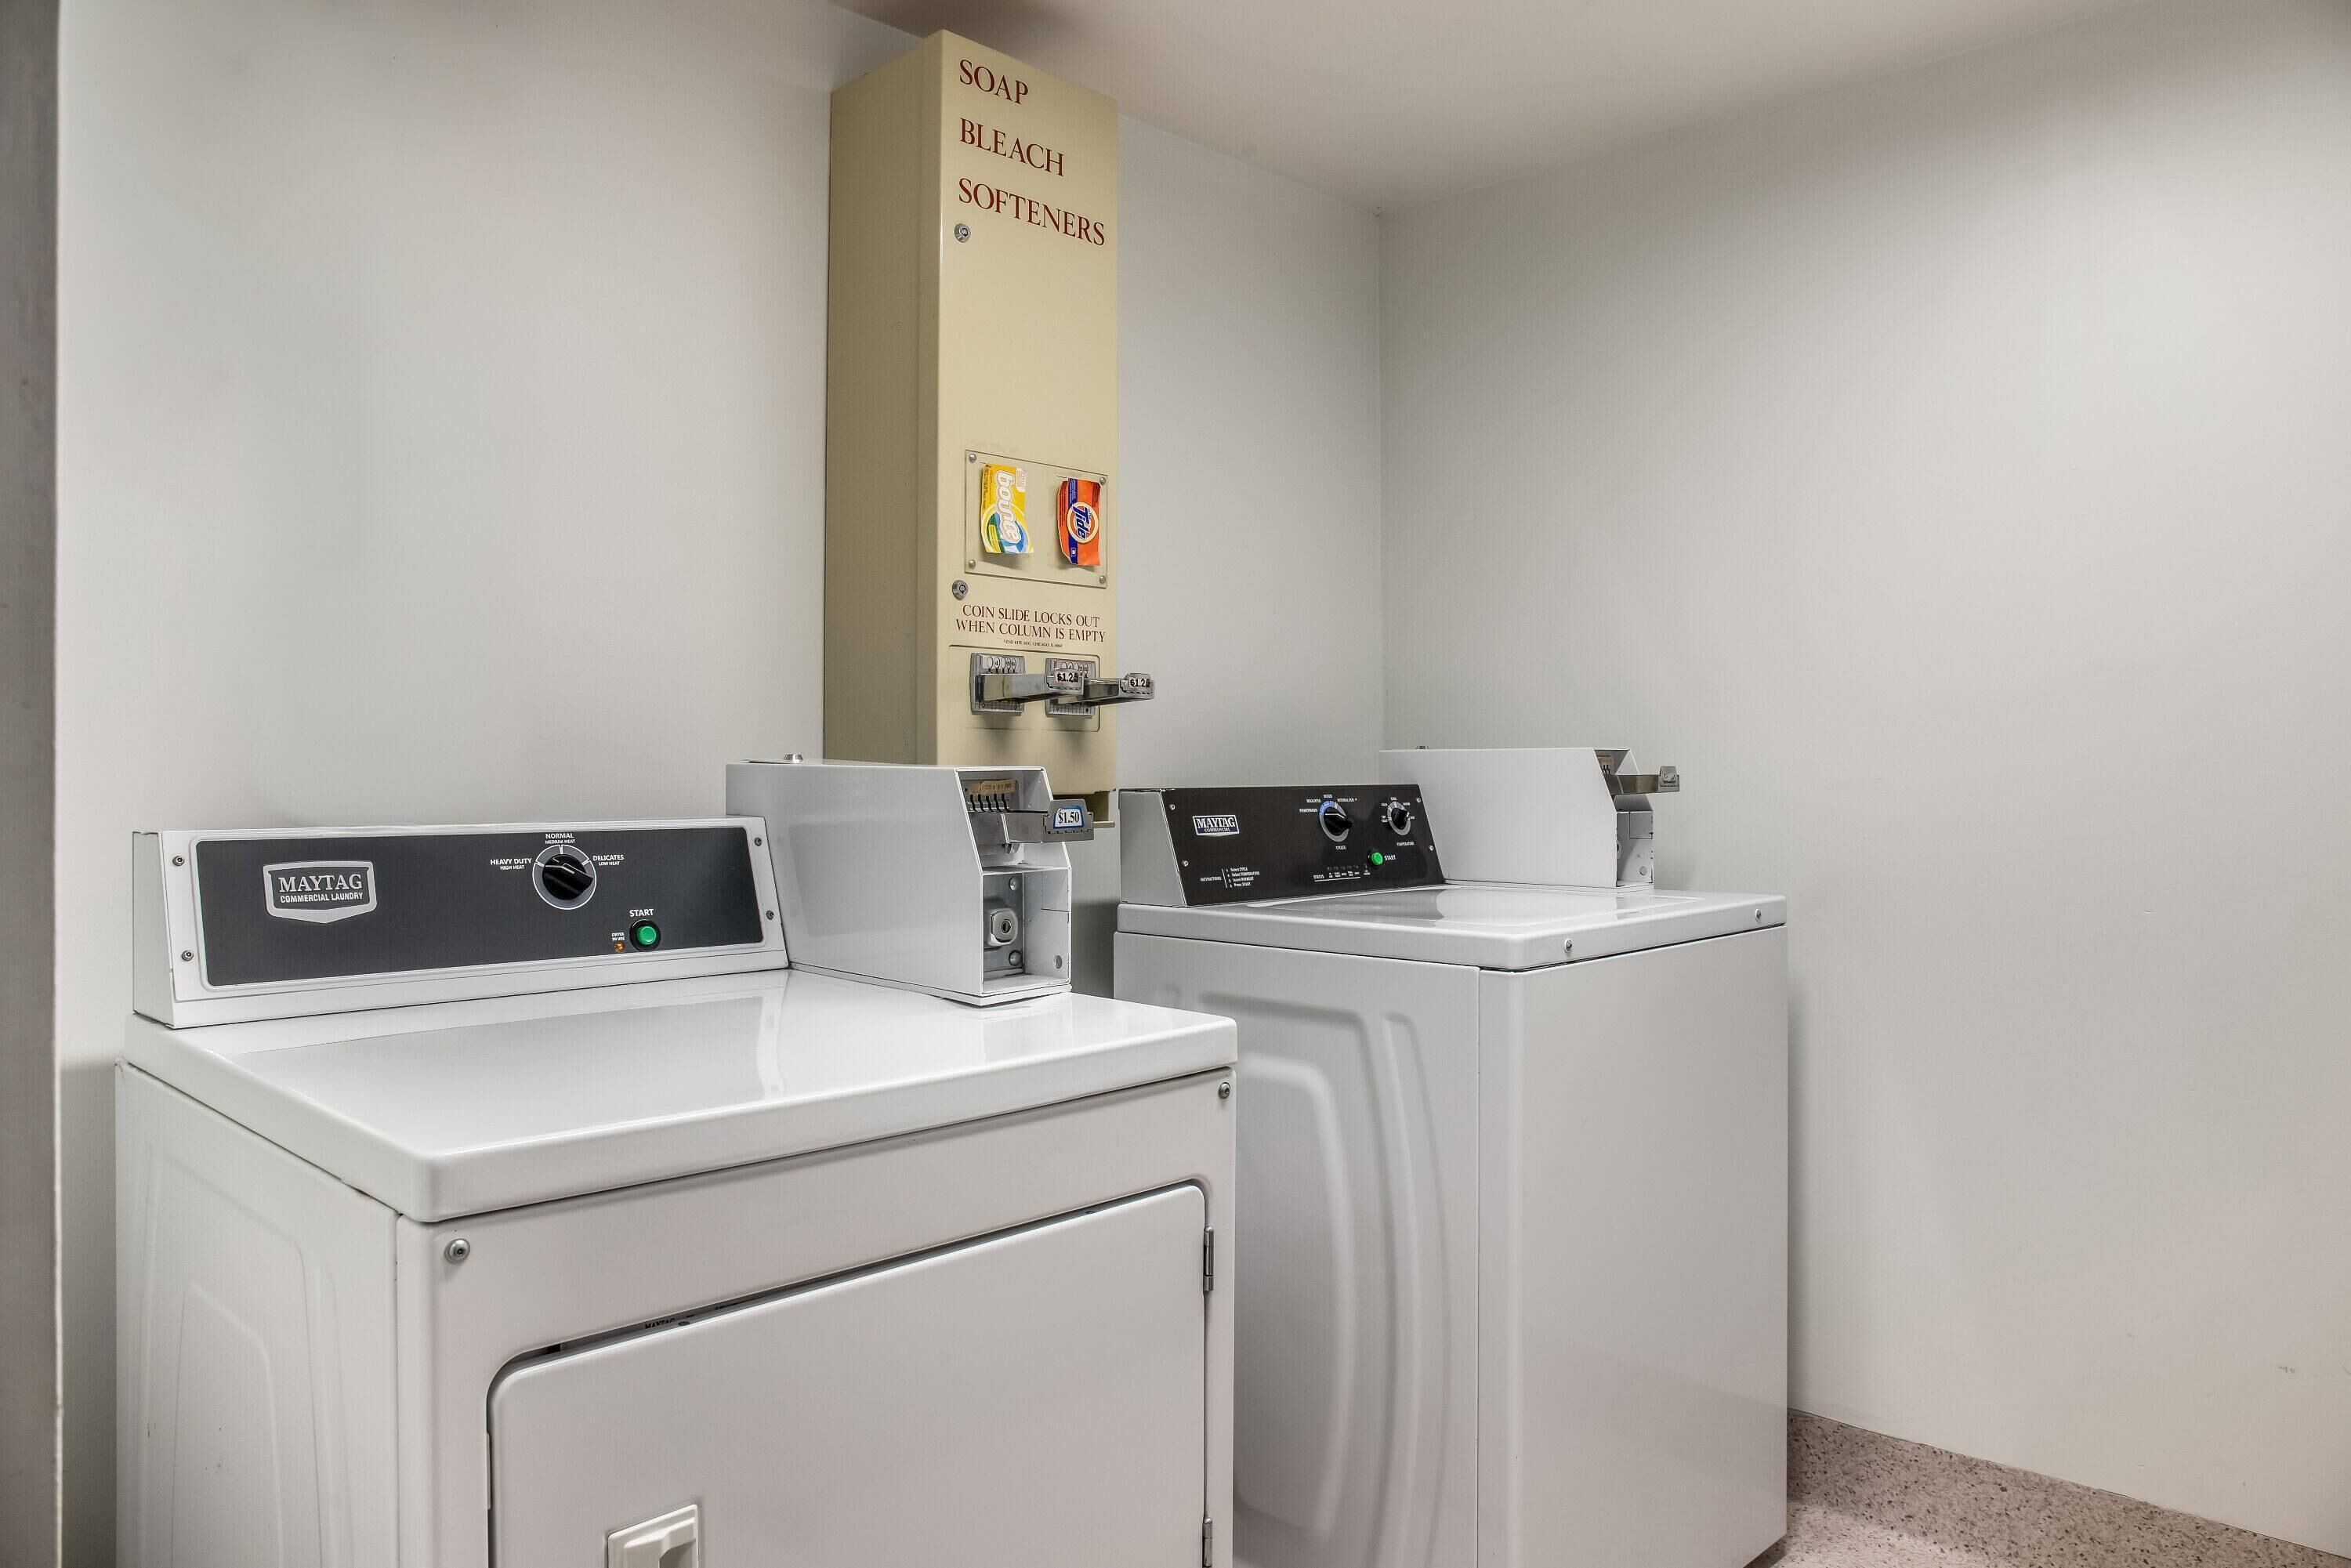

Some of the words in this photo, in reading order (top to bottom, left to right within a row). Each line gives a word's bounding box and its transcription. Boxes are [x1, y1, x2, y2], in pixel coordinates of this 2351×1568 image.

[959, 59, 1028, 104] SOAP
[960, 118, 1064, 176] BLEACH
[958, 178, 1105, 246] SOFTENERS
[994, 470, 1021, 544] bounce
[1072, 505, 1090, 539] Tide
[962, 604, 994, 617] COIN
[998, 608, 1030, 621] SLIDE
[1034, 610, 1072, 625] LOCKS
[1076, 615, 1100, 628] OUT
[956, 619, 994, 633] WHEN
[999, 623, 1051, 638] COLUMN
[1056, 628, 1065, 639] IS
[1069, 628, 1106, 643] EMPTY
[1129, 678, 1150, 688] $1.25
[1058, 811, 1080, 824] $1.50
[1196, 817, 1236, 828] MAYTAG
[278, 874, 363, 893] MAYTAG
[280, 893, 329, 904] COMMERCIAL
[331, 892, 364, 901] LAUNDRY
[629, 908, 654, 917] START
